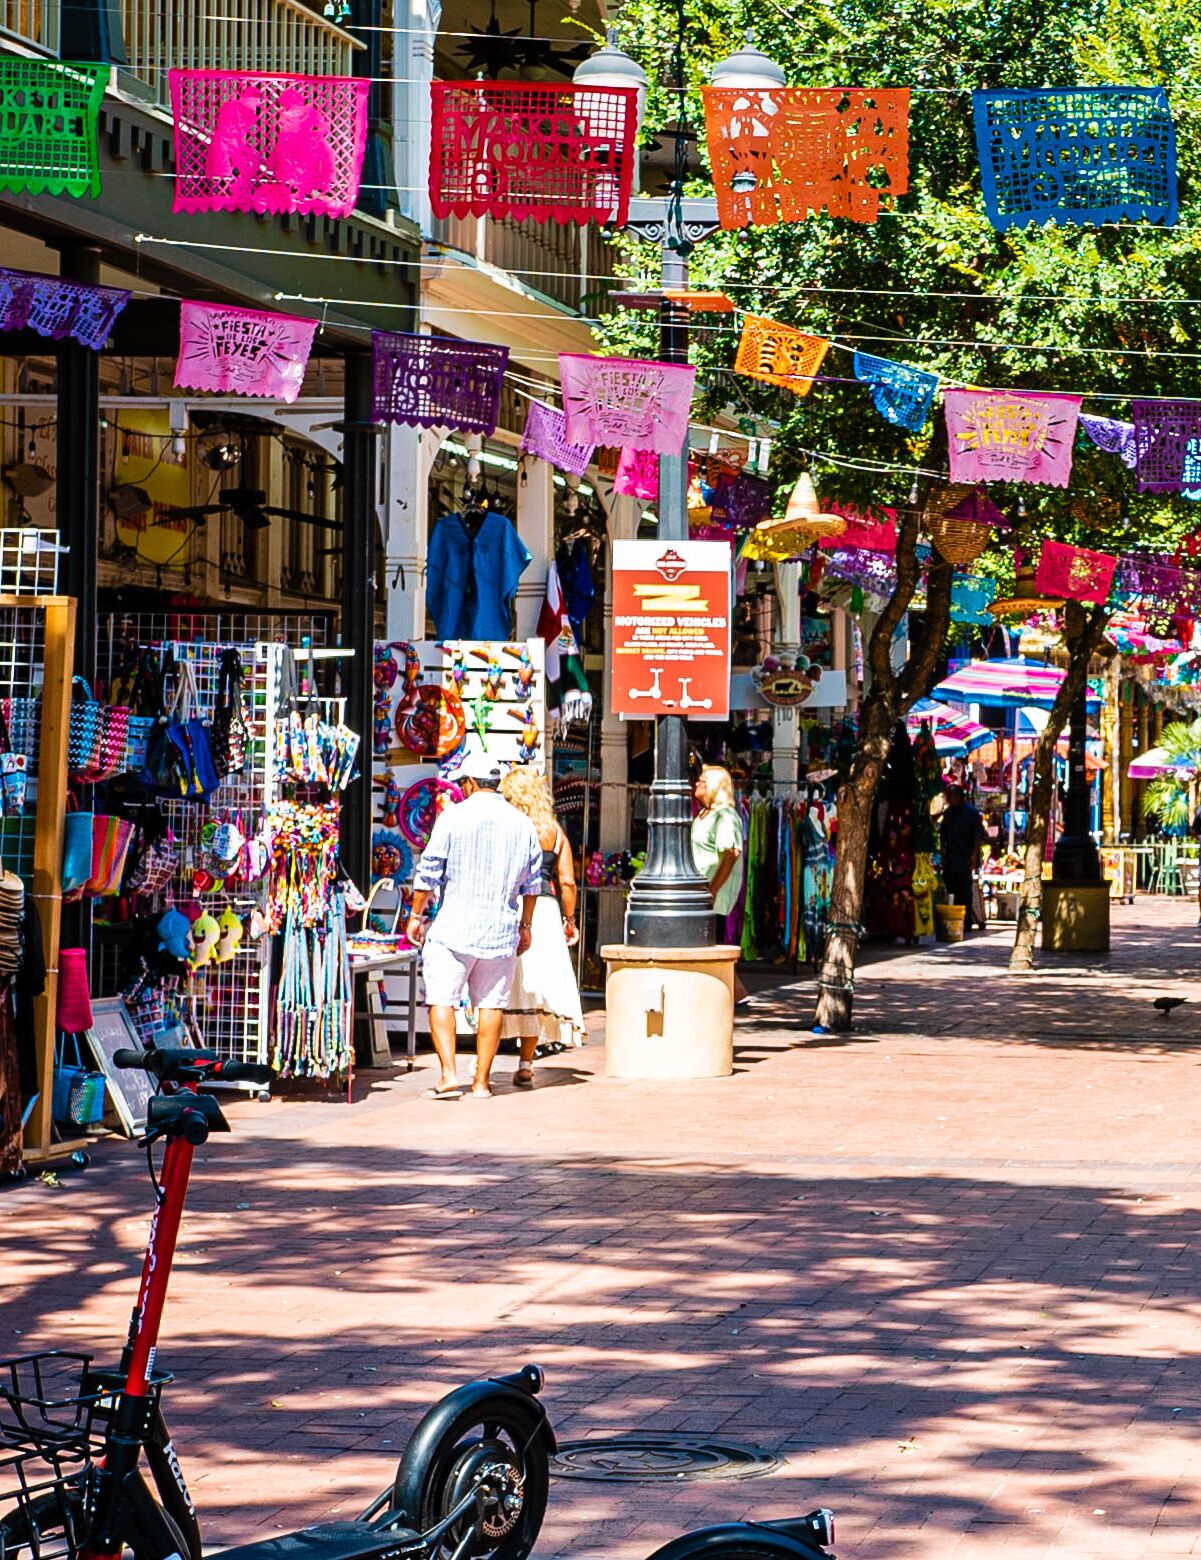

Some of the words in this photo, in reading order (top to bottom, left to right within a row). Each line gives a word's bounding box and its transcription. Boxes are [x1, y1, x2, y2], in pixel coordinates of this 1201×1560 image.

[453, 113, 589, 164] MARKET
[999, 118, 1145, 170] MARKET
[215, 341, 263, 361] REYES
[614, 616, 676, 627] MOTORIZED
[676, 617, 727, 628] VEHICLES
[634, 627, 651, 635] ARE
[652, 627, 668, 635] NOT
[668, 628, 705, 636] ALLOWED
